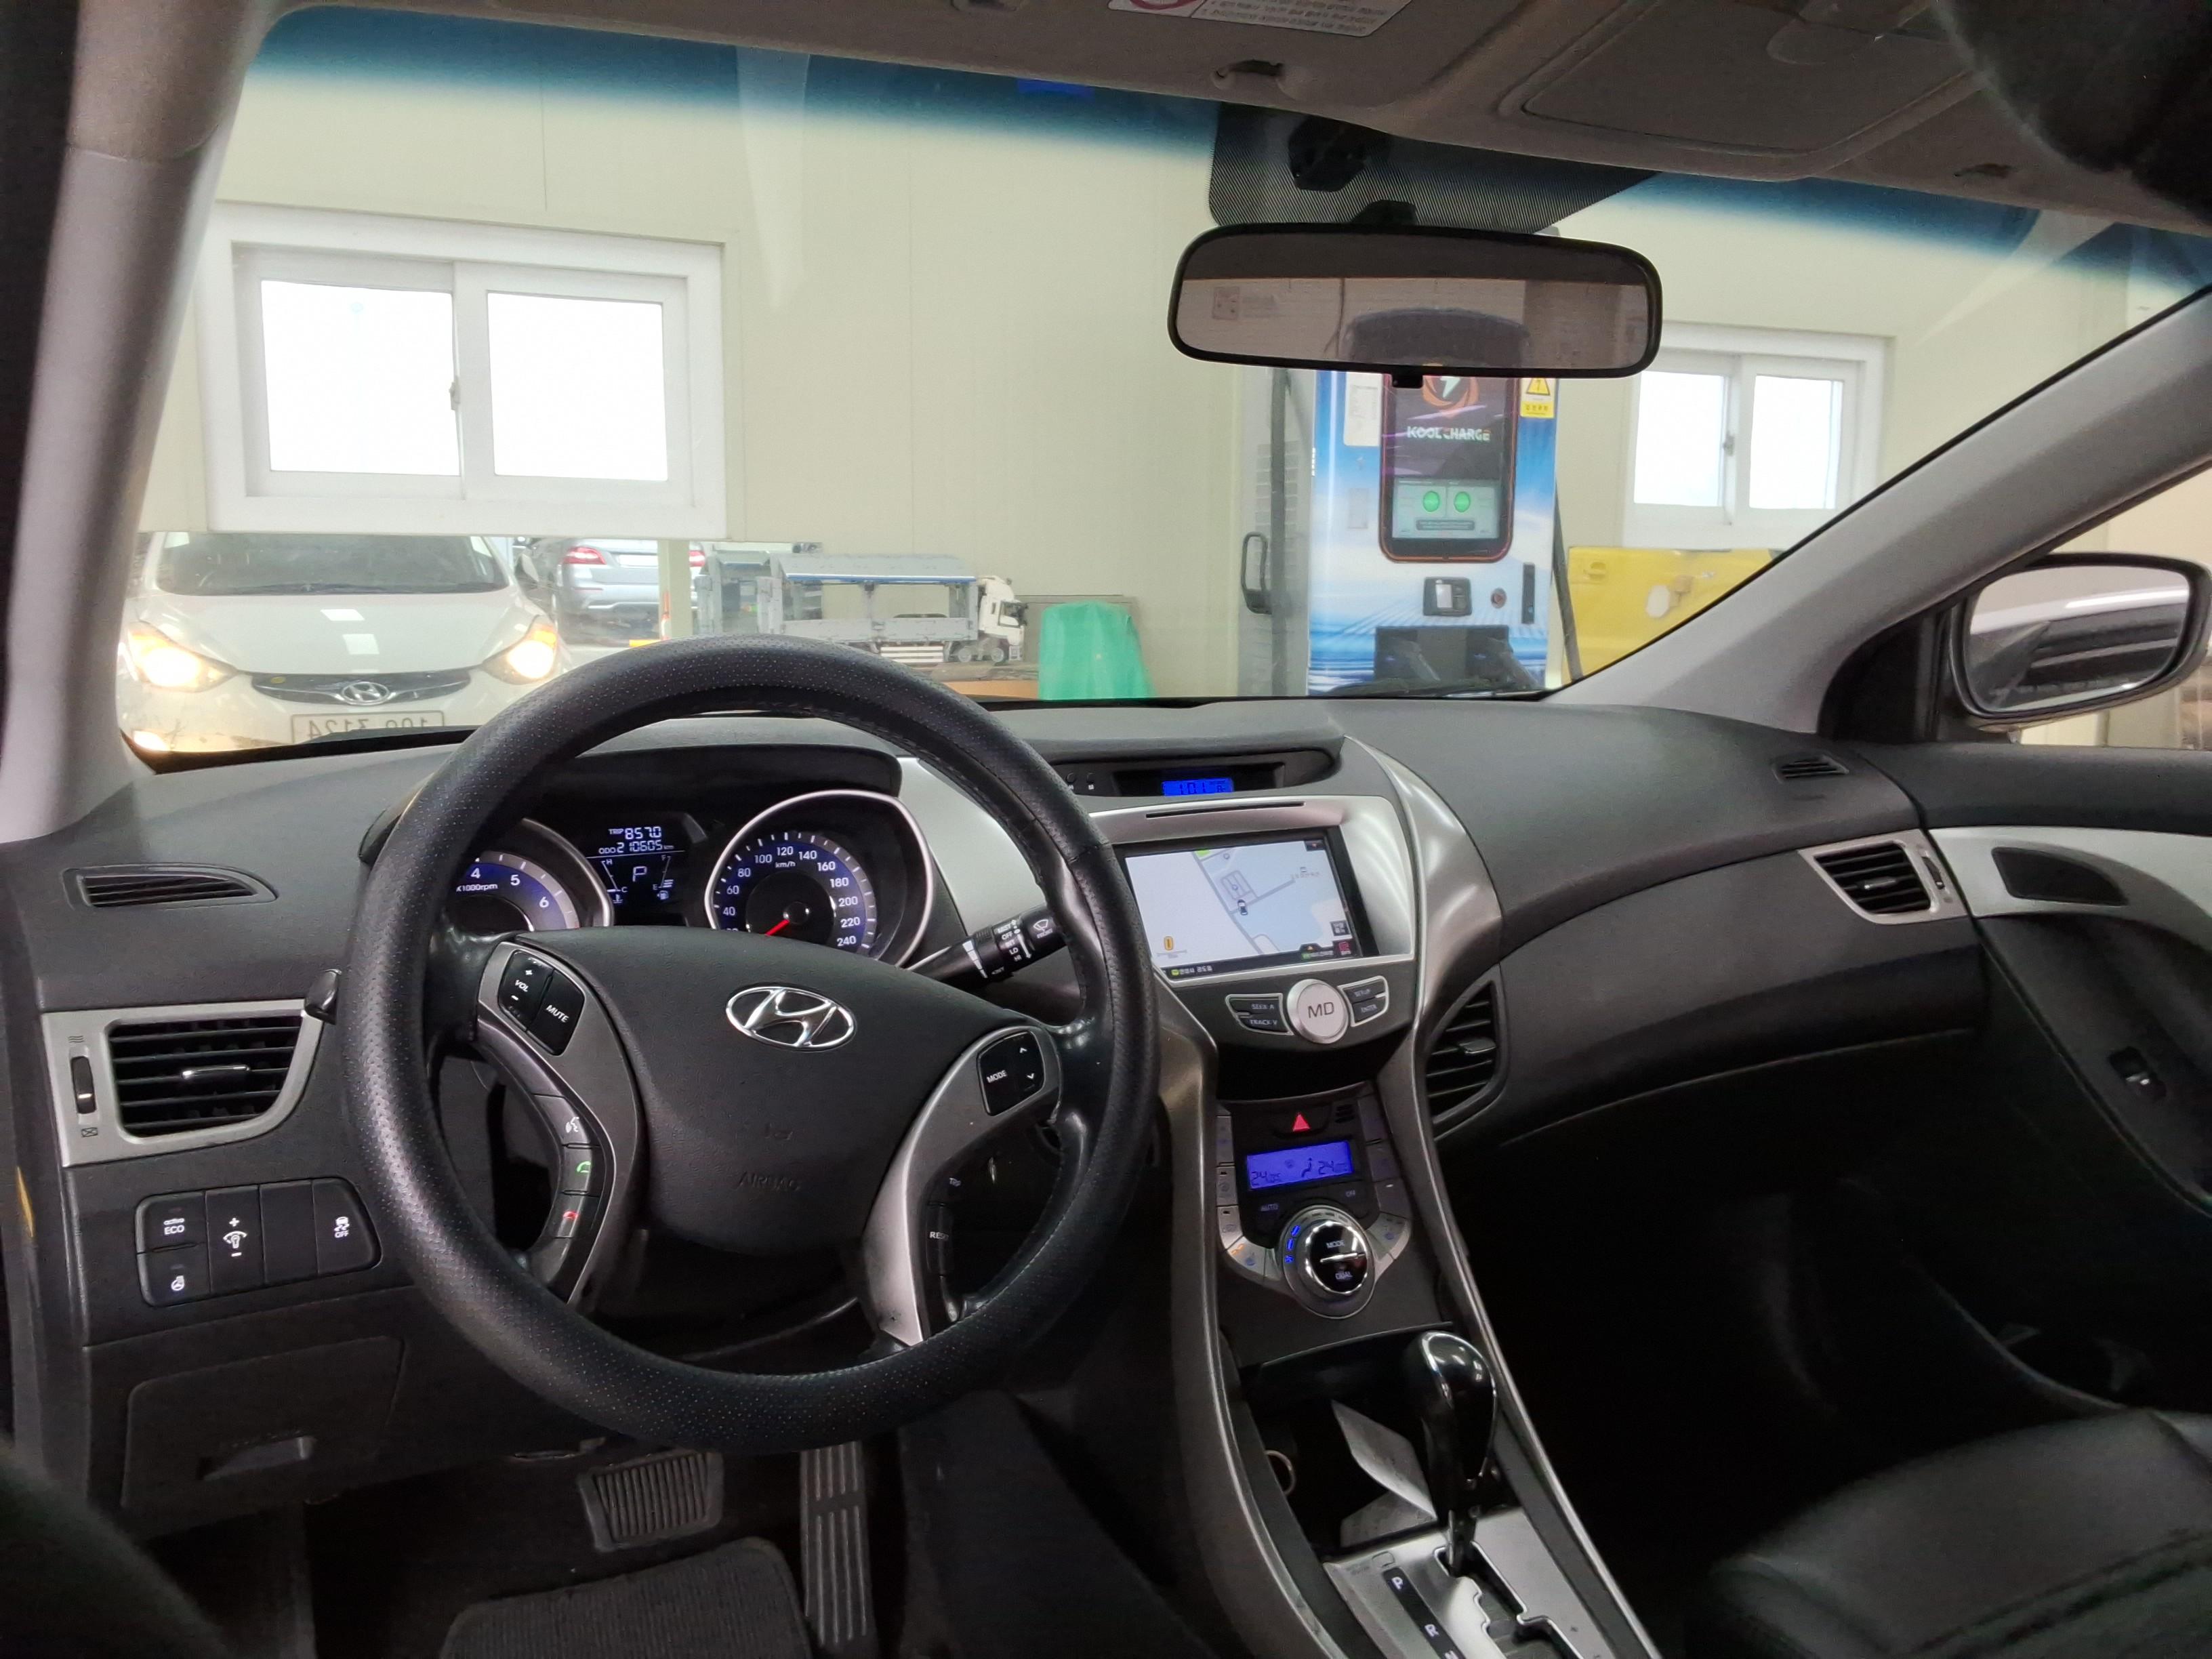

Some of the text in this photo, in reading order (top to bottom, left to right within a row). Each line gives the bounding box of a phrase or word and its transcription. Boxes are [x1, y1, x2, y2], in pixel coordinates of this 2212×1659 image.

[617, 840, 663, 853] 210605
[777, 846, 794, 856] 120
[754, 854, 773, 863] 100
[798, 851, 817, 861] 140
[817, 861, 836, 872] 160
[470, 867, 481, 879] 4
[632, 866, 647, 882] P
[737, 868, 751, 878] 80
[510, 874, 520, 886] 5
[830, 878, 849, 888] 180
[726, 885, 739, 895] 60
[539, 896, 550, 909] 6
[838, 897, 858, 907] 200
[723, 907, 735, 916] 40
[840, 917, 861, 928] 220
[1001, 931, 1013, 940] OFF
[837, 936, 857, 947] 240
[1009, 947, 1019, 955] LO
[515, 979, 529, 992] VOL
[546, 1004, 569, 1023] MUTE
[1307, 1002, 1334, 1019] MD
[986, 1069, 1008, 1083] MODE
[164, 1225, 185, 1235] ECO
[1326, 1240, 1345, 1248] MODE
[1391, 1576, 1404, 1591] P
[1425, 1624, 1439, 1637] R
